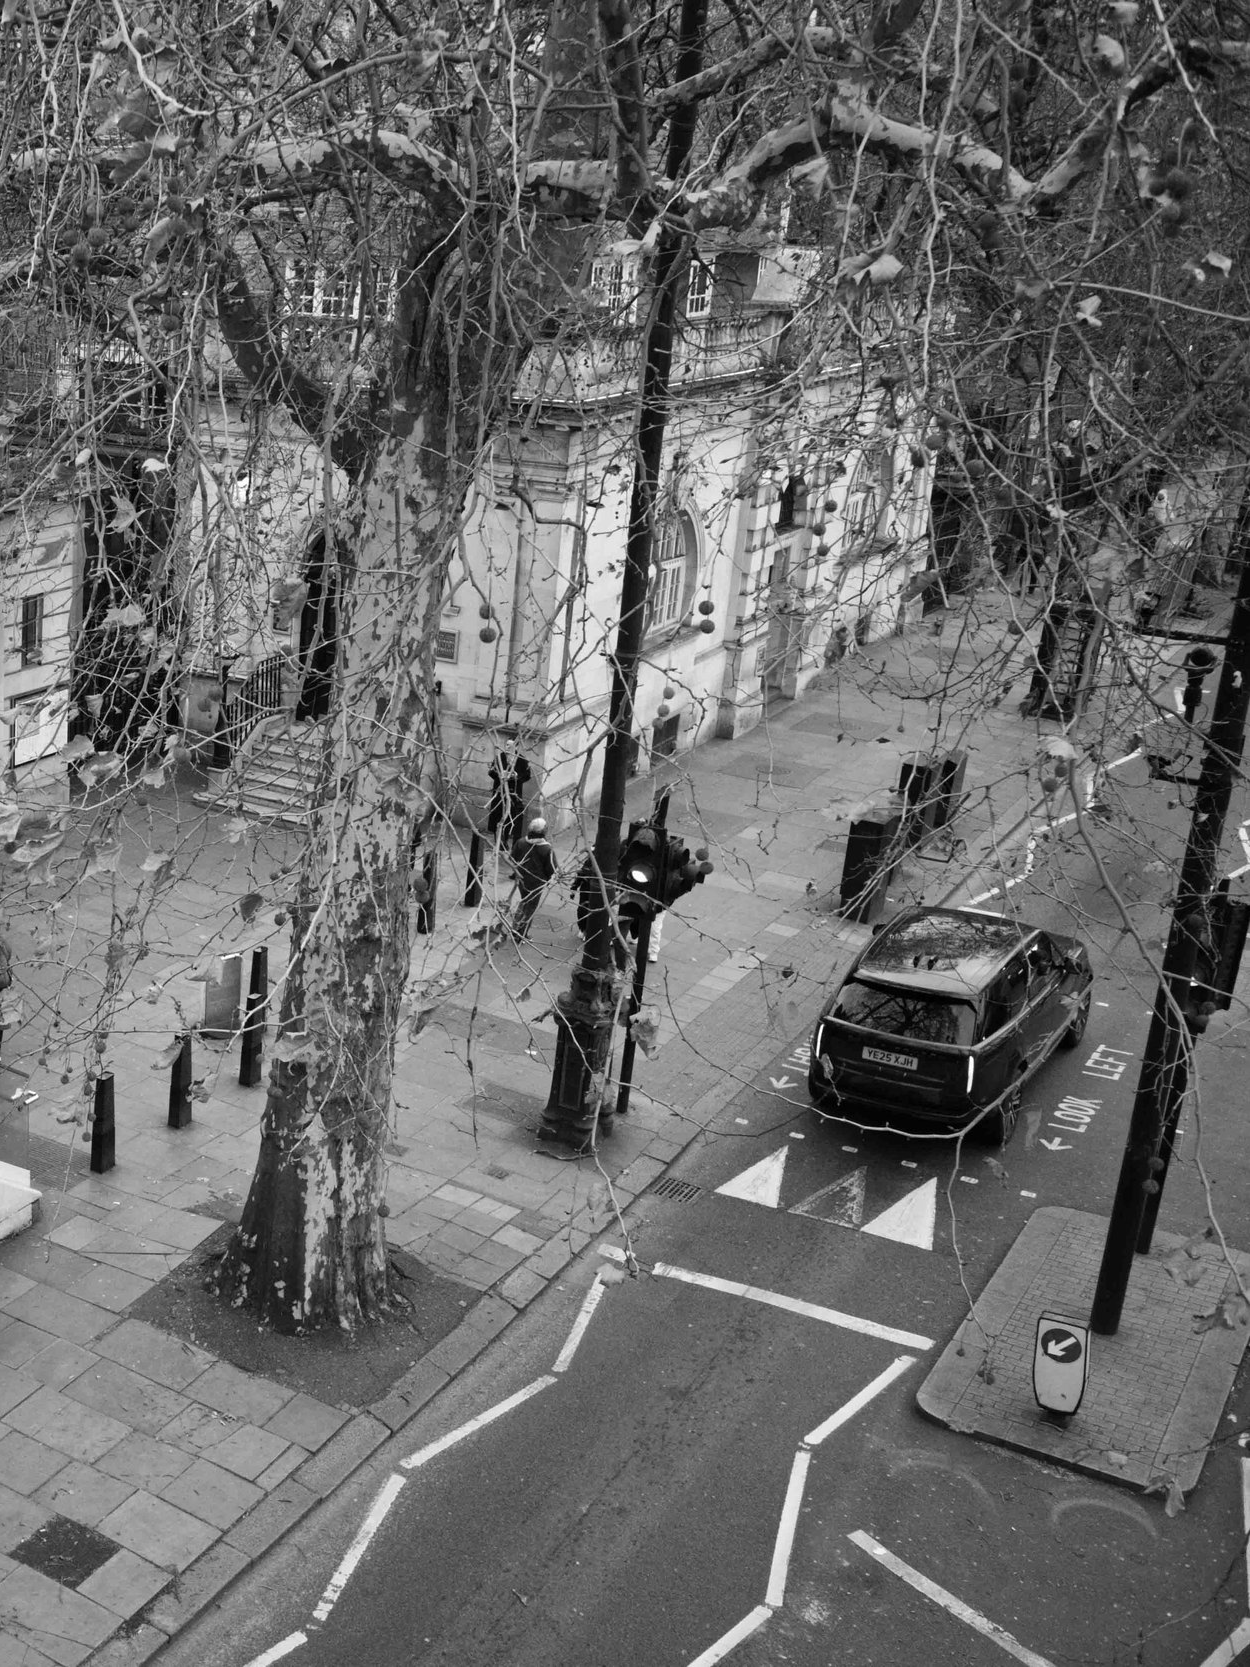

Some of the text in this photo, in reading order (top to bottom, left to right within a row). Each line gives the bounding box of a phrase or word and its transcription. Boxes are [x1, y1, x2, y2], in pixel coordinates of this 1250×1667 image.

[867, 1049, 914, 1068] YE25 XJH
[1048, 1044, 1134, 1133] LOOK LEFT
